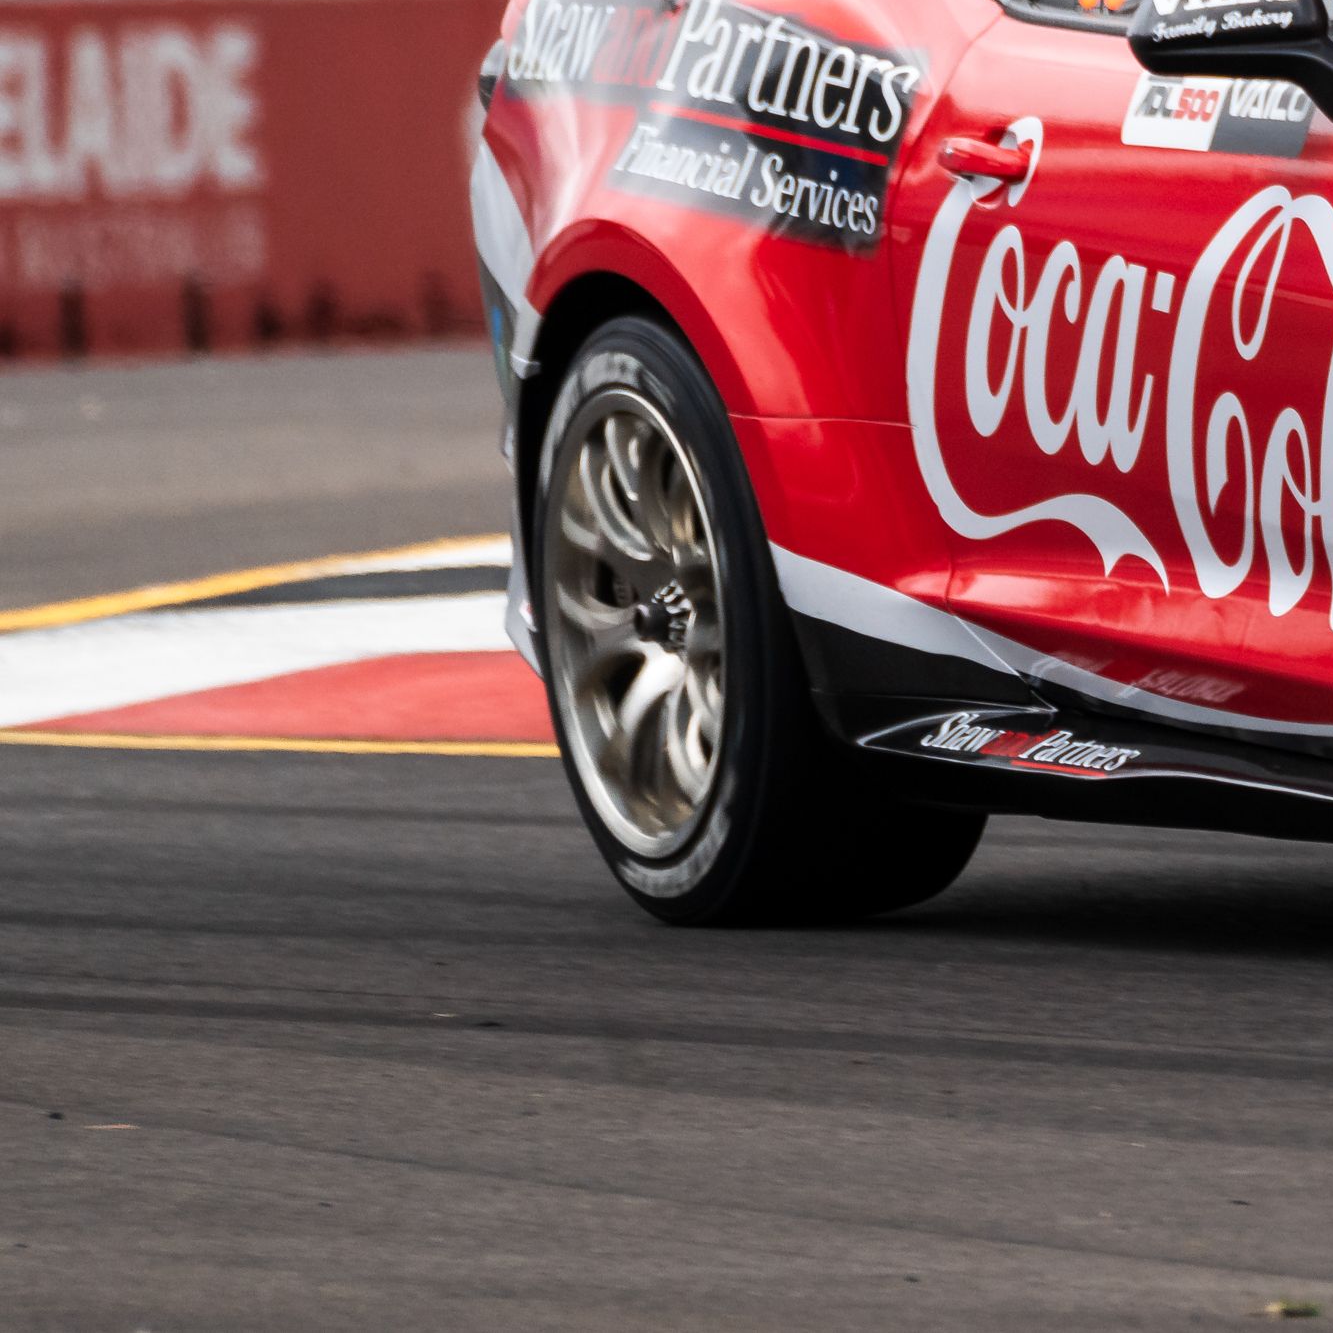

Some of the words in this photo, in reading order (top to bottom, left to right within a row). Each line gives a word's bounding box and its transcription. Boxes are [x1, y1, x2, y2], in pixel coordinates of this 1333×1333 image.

[1152, 14, 1218, 43] Family
[1220, 8, 1294, 32] Bakery
[612, 121, 759, 201] Financial
[750, 152, 880, 236] Services
